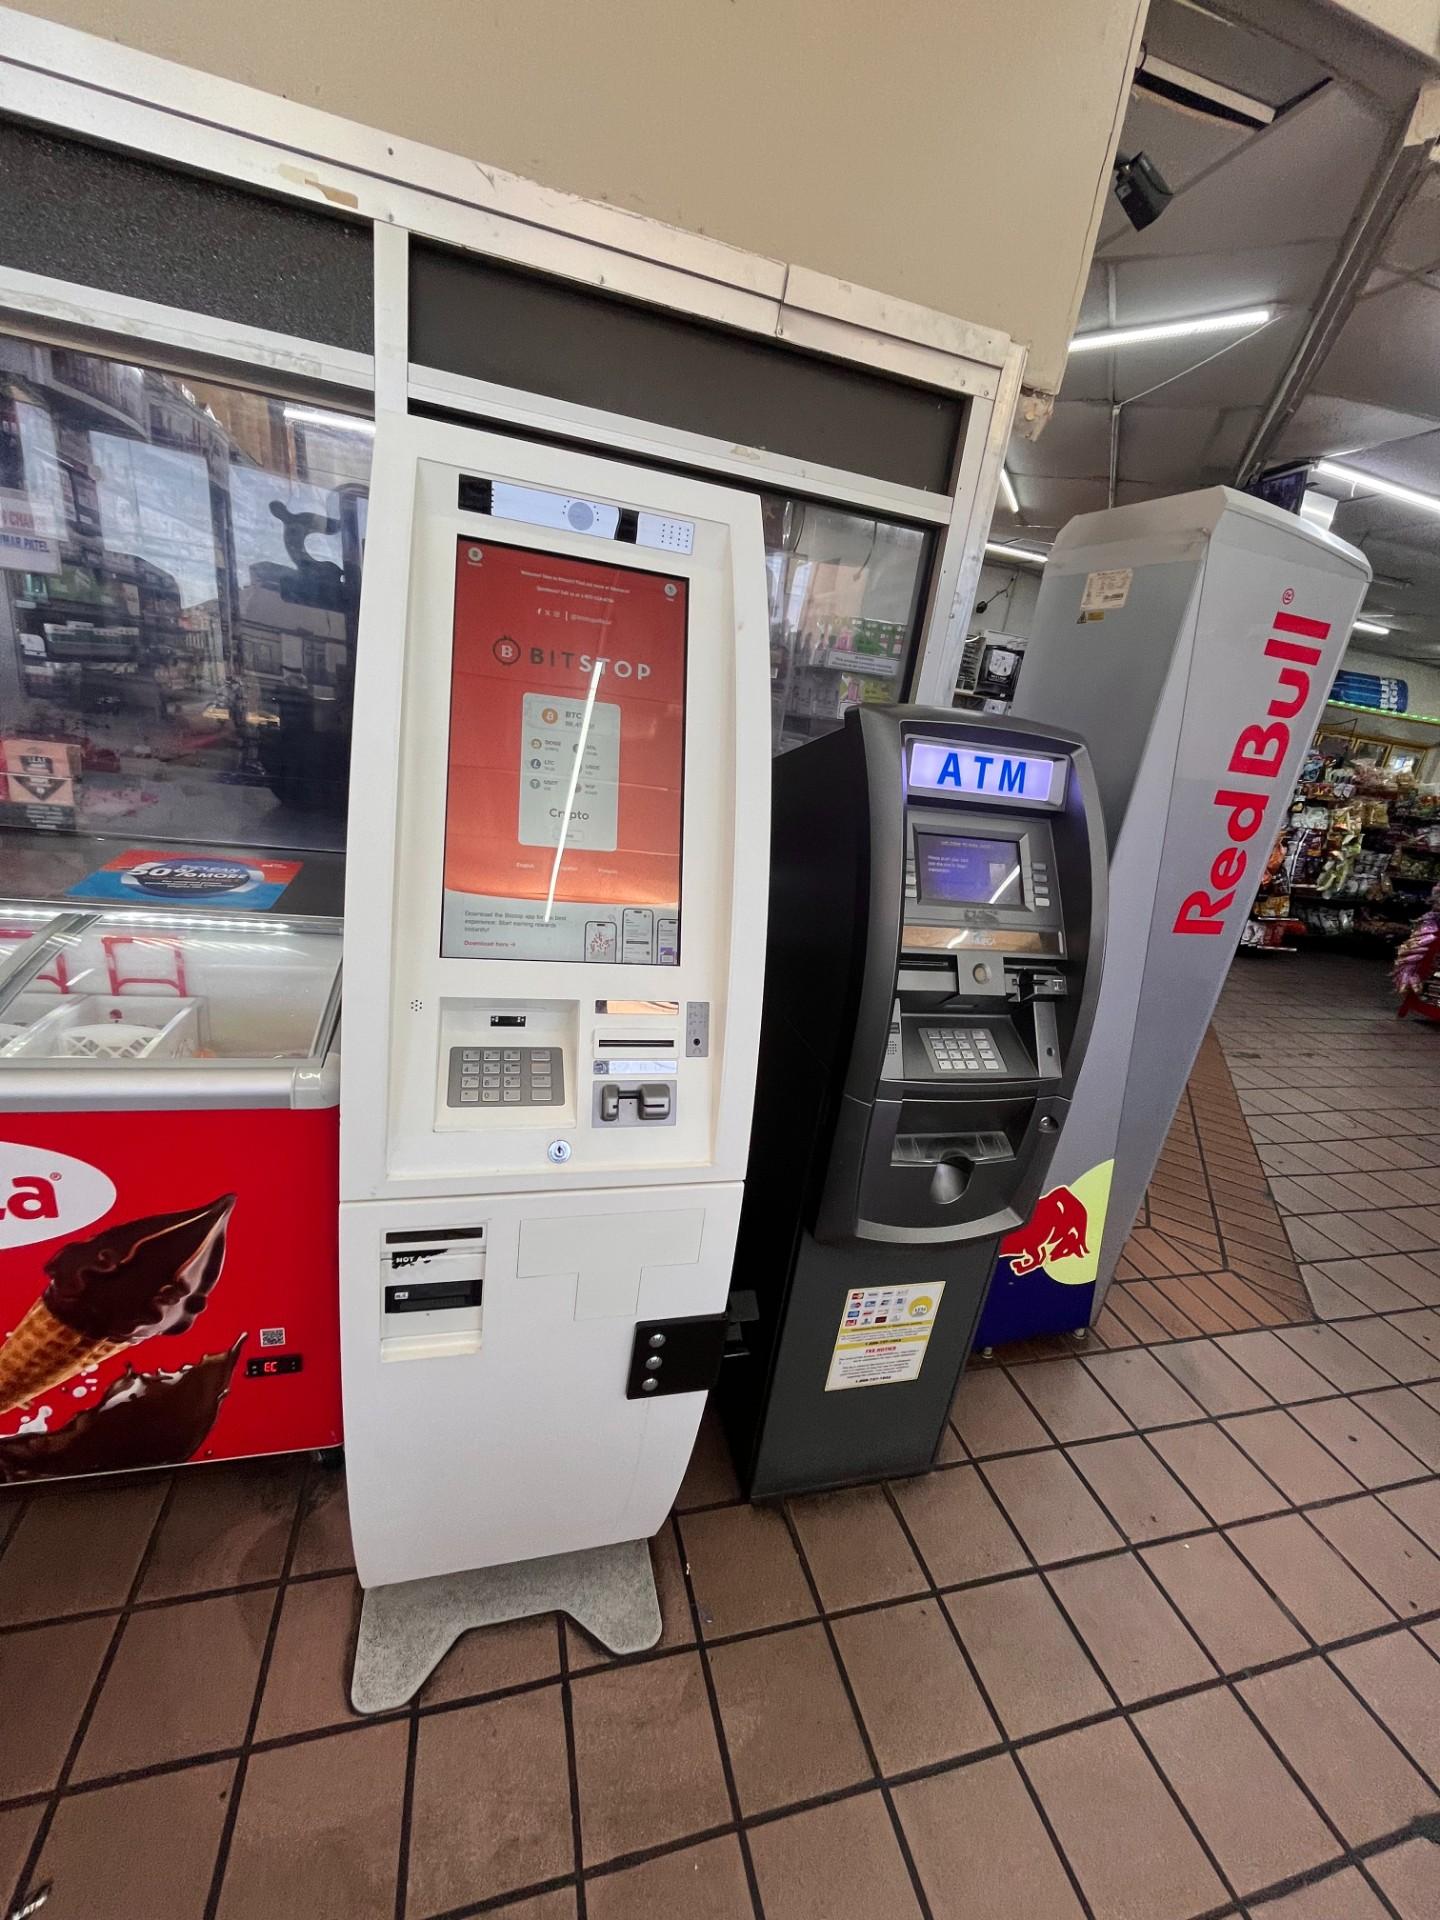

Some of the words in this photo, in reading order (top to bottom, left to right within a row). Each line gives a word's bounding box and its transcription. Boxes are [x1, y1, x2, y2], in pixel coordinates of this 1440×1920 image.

[530, 647, 651, 681] BITSTOP
[565, 711, 582, 719] BTC
[937, 752, 1027, 794] ATM
[1171, 789, 1270, 936] Red
[1227, 611, 1332, 778] Bull
[0, 1175, 60, 1220] a
